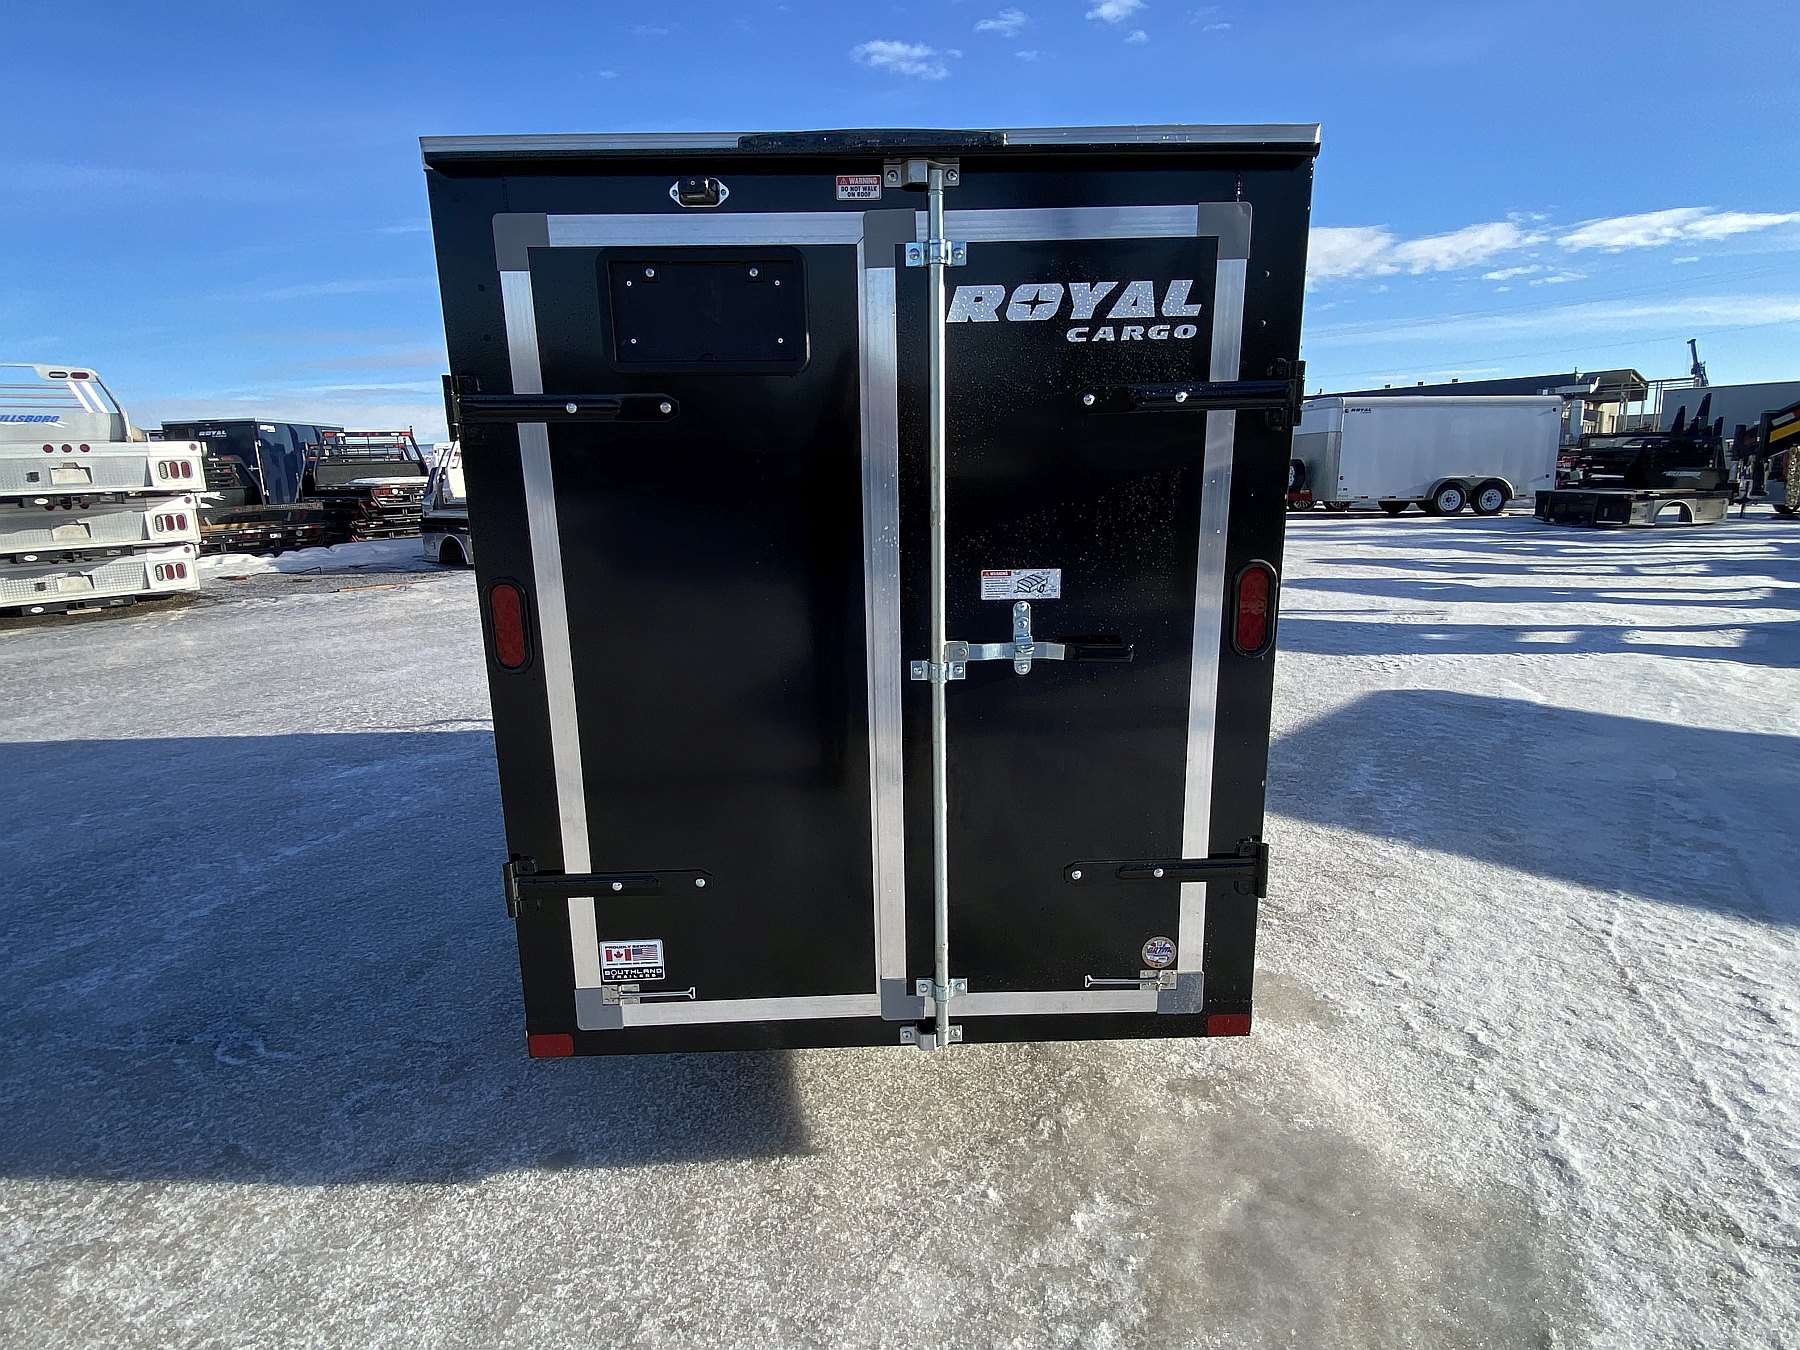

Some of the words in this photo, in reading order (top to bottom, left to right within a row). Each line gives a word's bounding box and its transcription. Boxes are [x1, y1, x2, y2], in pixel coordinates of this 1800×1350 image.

[849, 177, 878, 185] WARNING
[946, 279, 1202, 323] ROYAL
[1066, 324, 1198, 343] CARGO
[604, 968, 663, 976] SOUTHLAND
